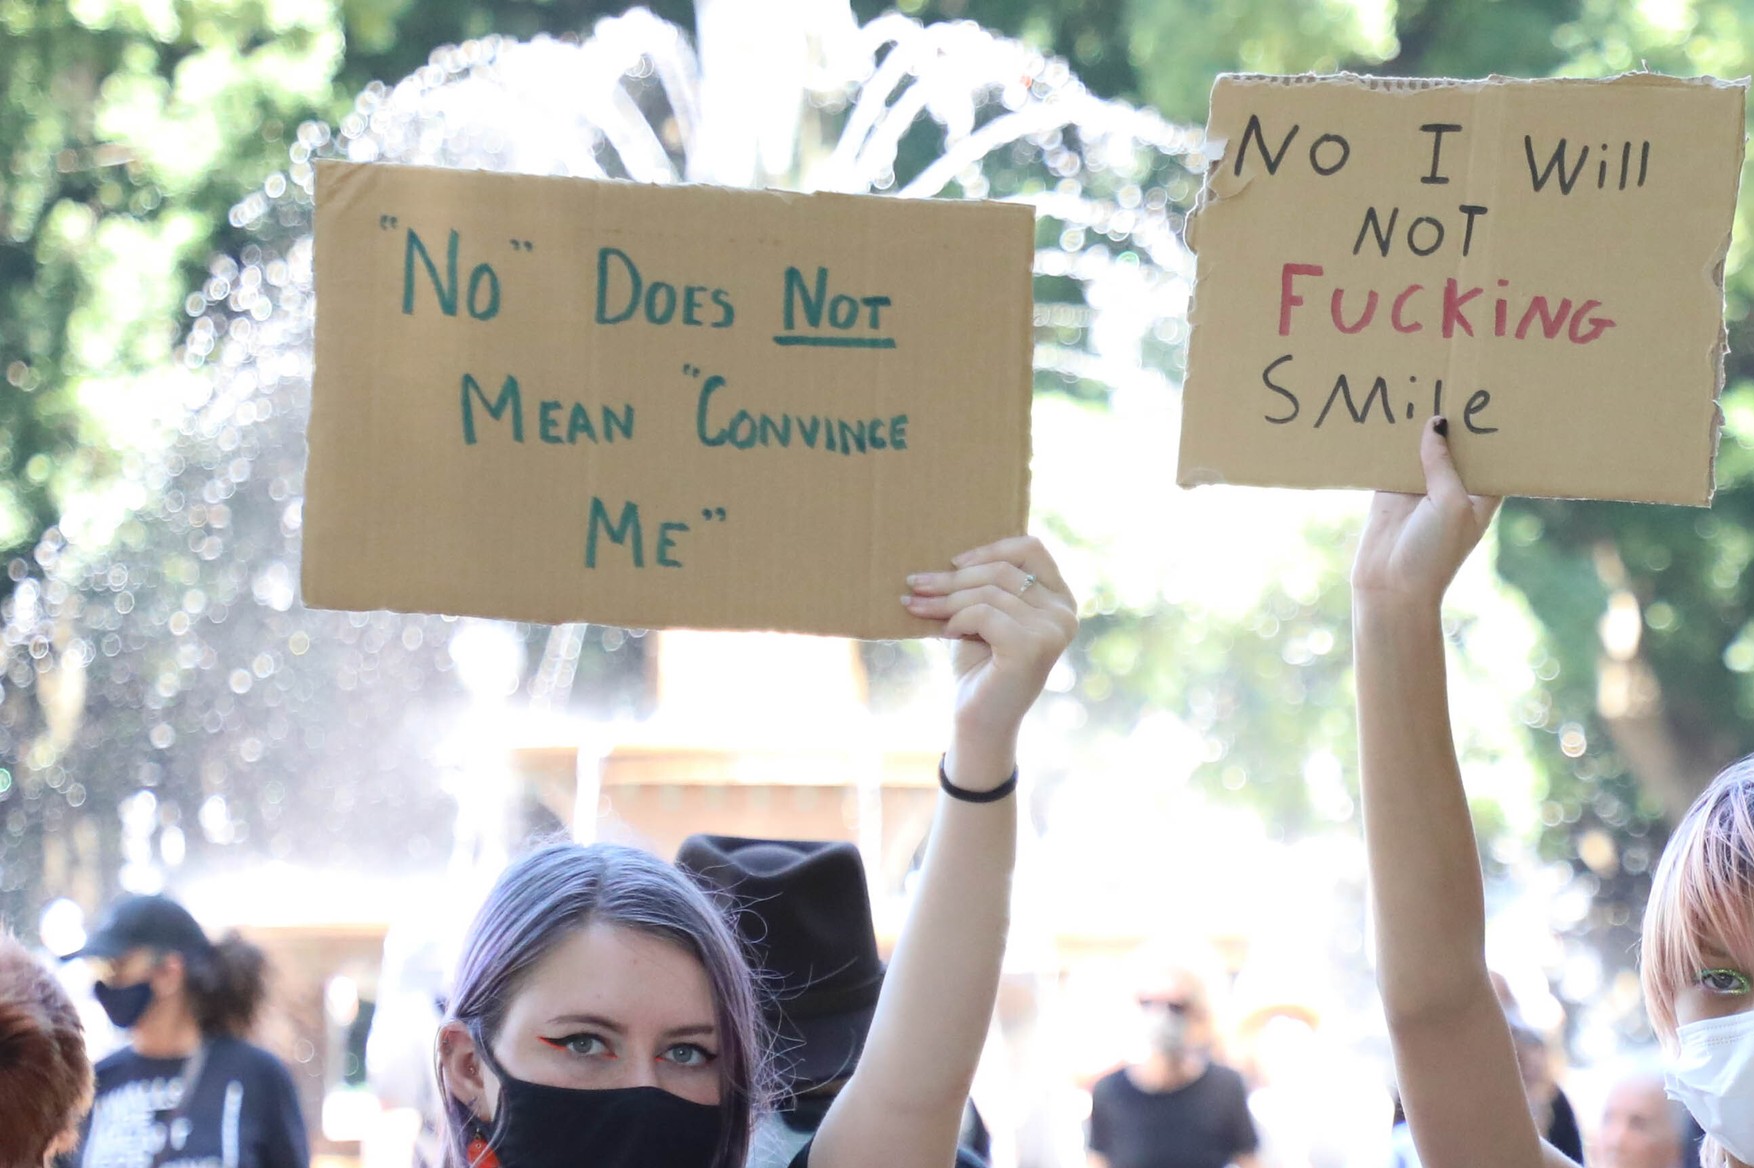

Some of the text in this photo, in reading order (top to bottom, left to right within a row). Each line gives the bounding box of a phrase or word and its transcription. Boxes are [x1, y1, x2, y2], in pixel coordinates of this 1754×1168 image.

[1233, 114, 1351, 177] NO
[1420, 123, 1463, 185] I
[1352, 204, 1488, 258] NOT
[593, 246, 736, 328] DOES
[772, 265, 897, 349] NOT
[460, 372, 635, 446] MEAN
